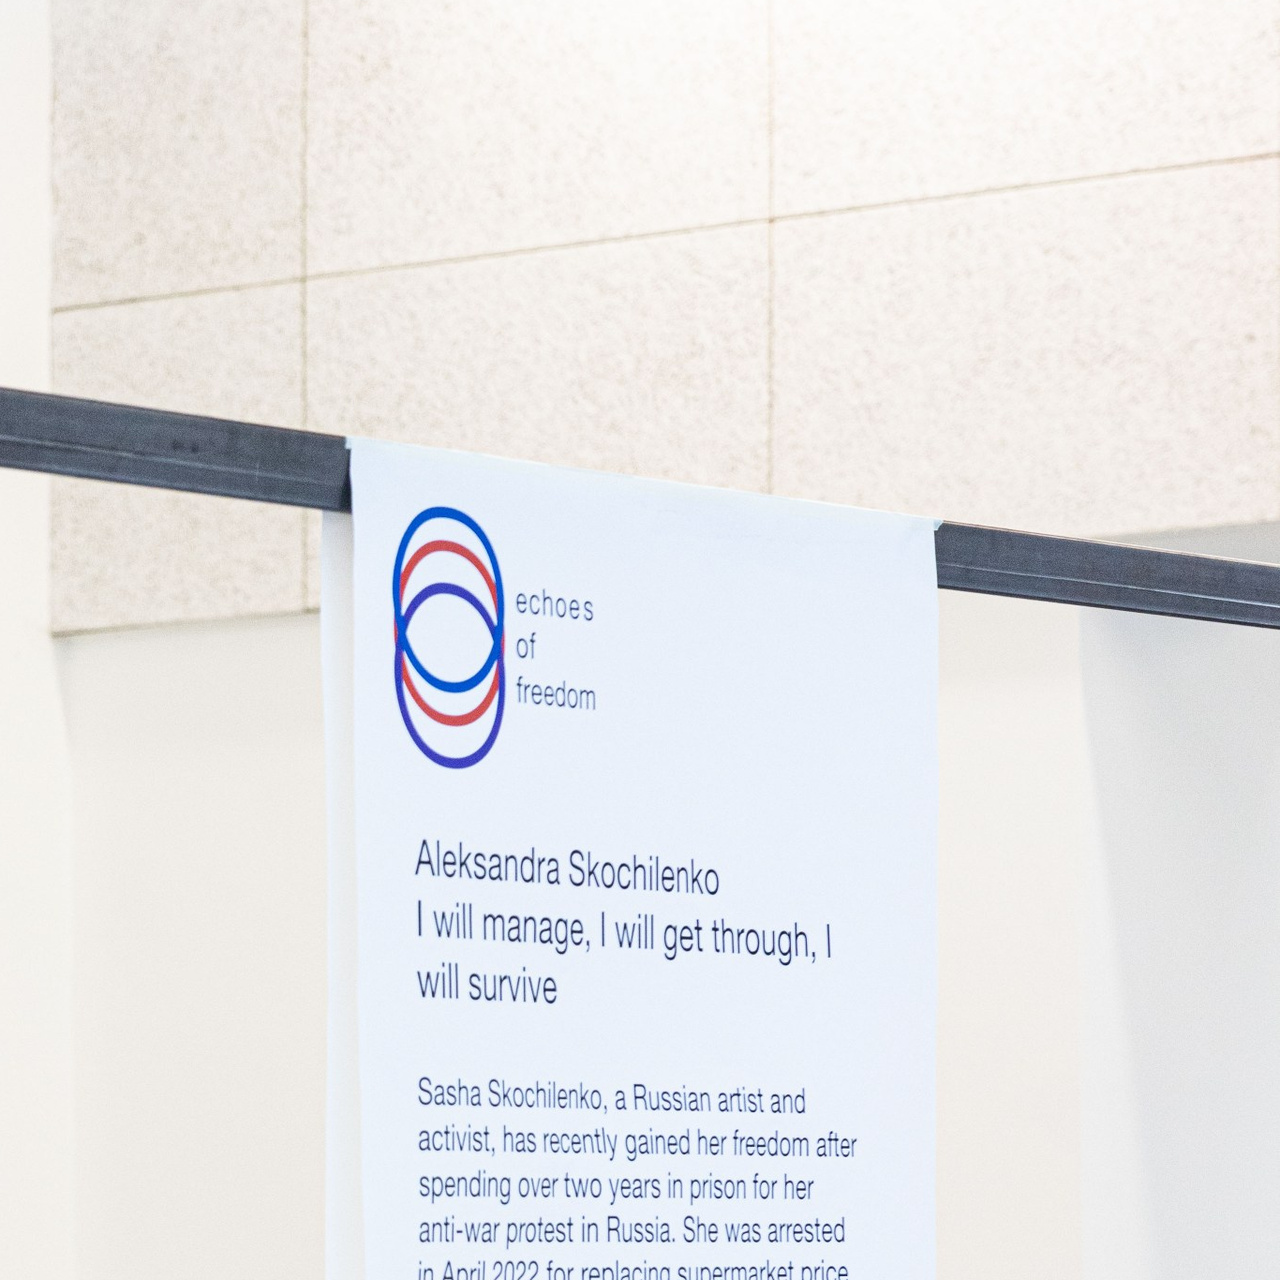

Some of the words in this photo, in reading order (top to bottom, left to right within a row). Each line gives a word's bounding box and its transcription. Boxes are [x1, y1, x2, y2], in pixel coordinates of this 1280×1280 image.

[516, 589, 593, 621] echoes
[517, 632, 536, 659] of
[516, 676, 595, 710] freedom
[415, 839, 560, 885] Aleksandra
[569, 849, 719, 895] Skochilenko
[417, 900, 423, 936] I
[433, 902, 472, 939] will
[484, 914, 590, 955] manage,
[601, 912, 606, 947] I
[615, 914, 653, 949] will
[664, 919, 703, 961] get
[712, 918, 815, 966] through,
[826, 924, 832, 958] I
[417, 962, 458, 999] will
[469, 967, 557, 1004] survive
[418, 1077, 481, 1106] Sasha
[489, 1079, 607, 1114] Skochilenko,
[615, 1090, 627, 1110] a
[633, 1084, 711, 1111] Russian
[718, 1087, 764, 1113] artist
[771, 1088, 805, 1114] and
[419, 1124, 495, 1156] activist,
[504, 1125, 536, 1153] has
[544, 1127, 617, 1161] recently
[625, 1128, 690, 1161] gained
[698, 1129, 727, 1155] her
[733, 1129, 809, 1156] freedom
[817, 1131, 857, 1157] after
[419, 1215, 500, 1243] anti-war
[507, 1217, 573, 1249] protest
[582, 1216, 598, 1242] in
[608, 1216, 675, 1243] Russia.
[683, 1215, 718, 1243] She
[725, 1223, 761, 1243] was
[768, 1217, 845, 1243] arrested
